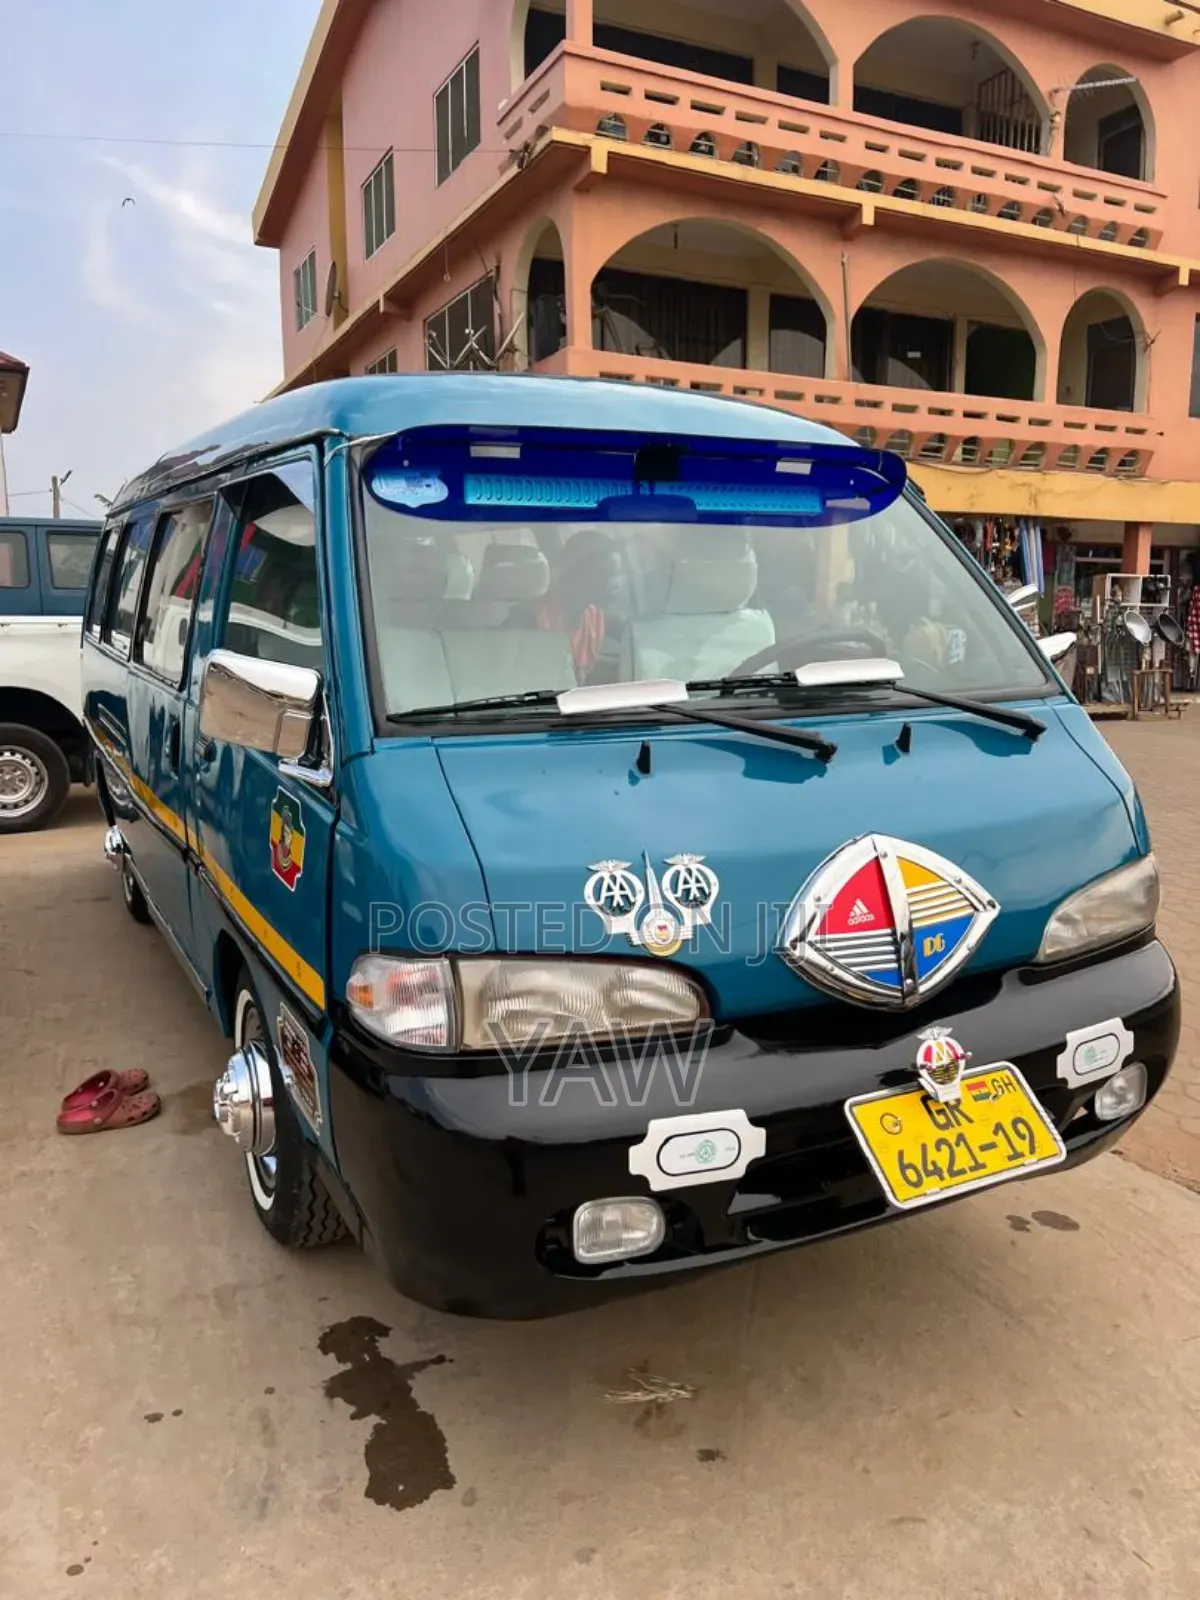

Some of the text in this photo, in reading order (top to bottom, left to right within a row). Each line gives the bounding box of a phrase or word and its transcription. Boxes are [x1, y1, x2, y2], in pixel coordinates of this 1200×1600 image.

[595, 871, 635, 908] AA
[674, 865, 711, 901] AA
[847, 913, 875, 926] adidas
[897, 1117, 1037, 1189] 6421-19
